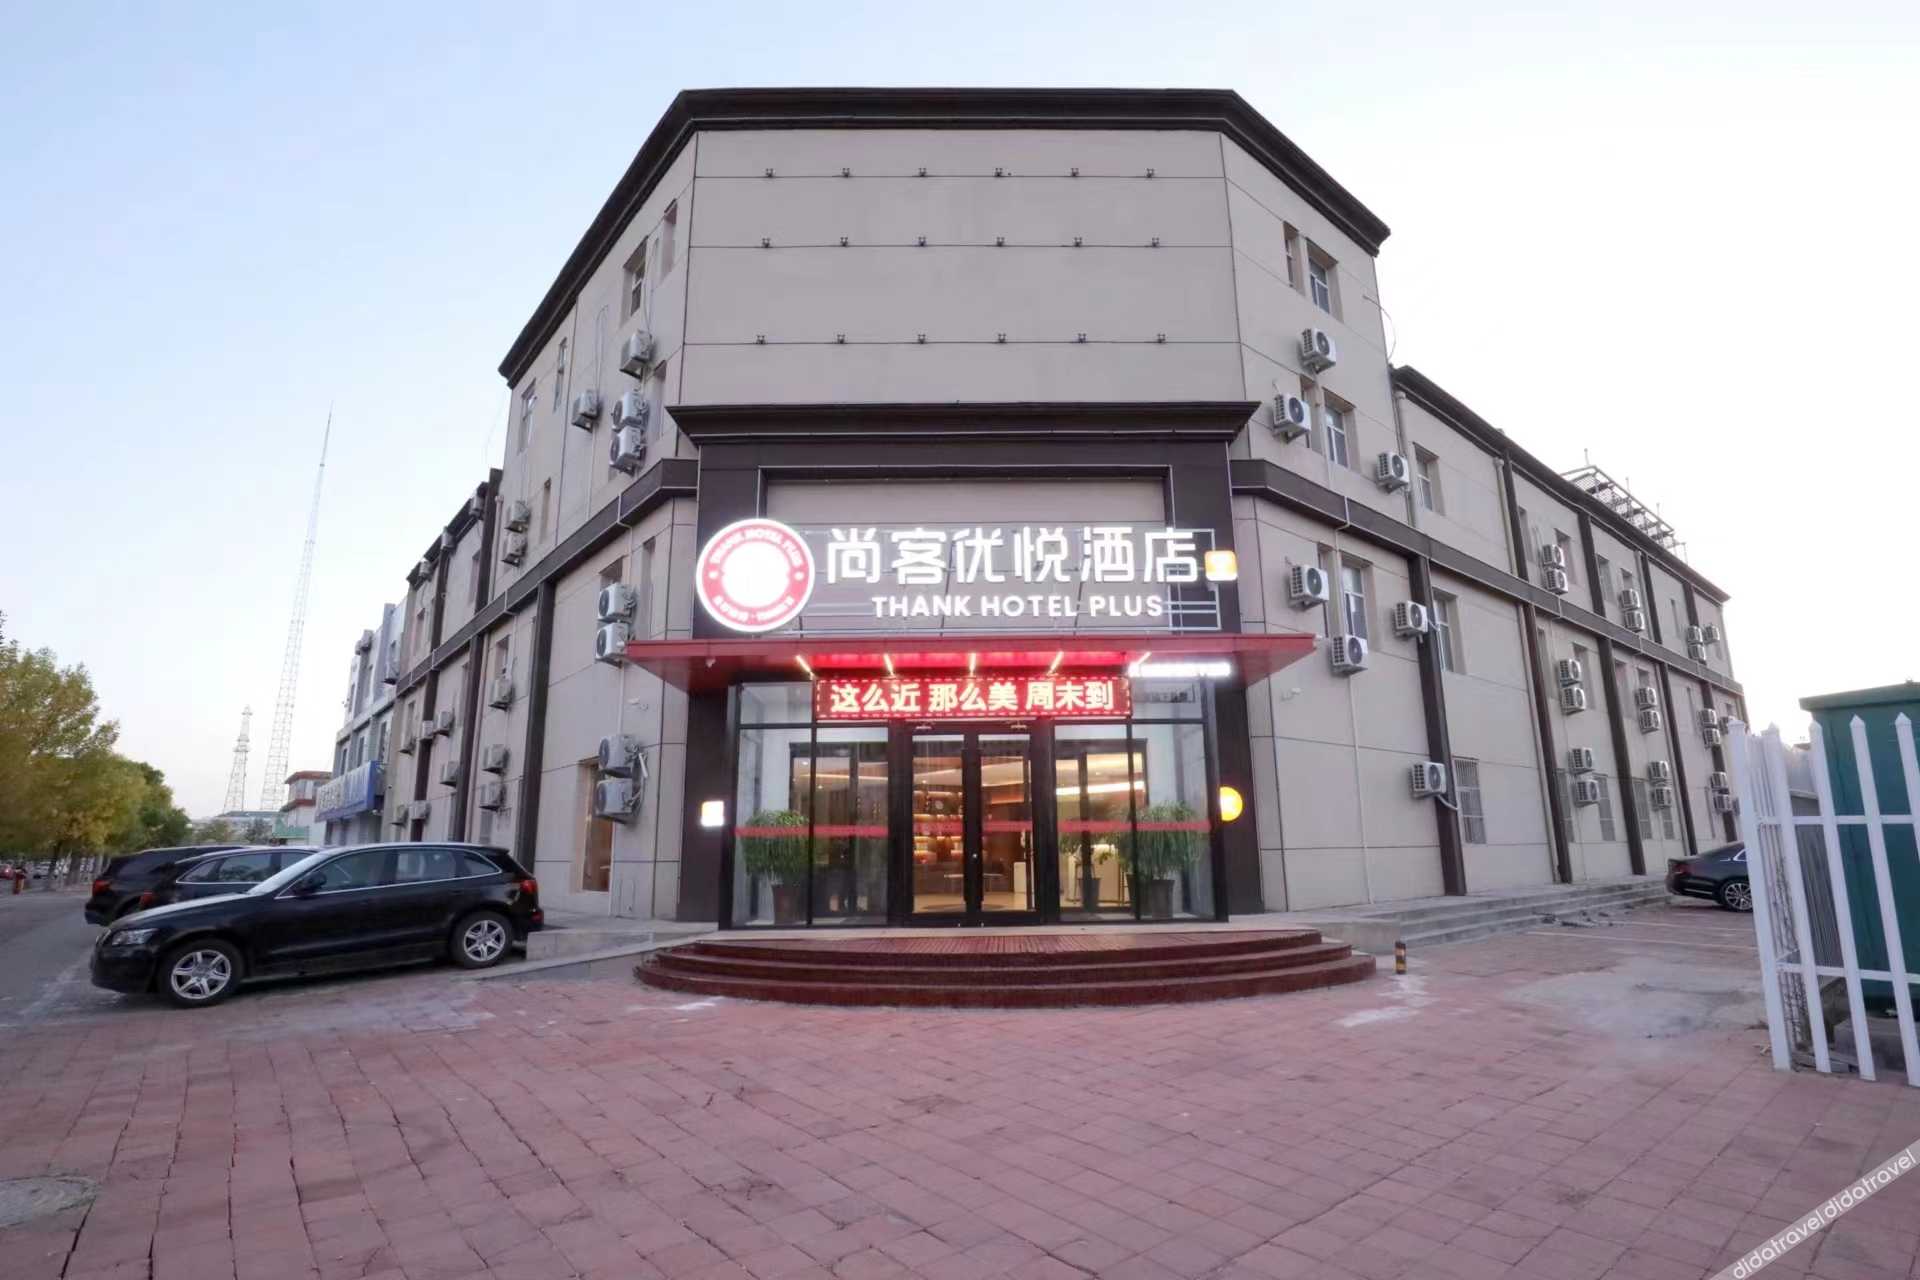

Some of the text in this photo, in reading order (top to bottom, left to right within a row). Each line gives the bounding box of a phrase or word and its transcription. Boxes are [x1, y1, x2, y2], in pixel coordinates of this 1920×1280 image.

[828, 526, 1198, 585] 尚客优悦酒店
[871, 594, 1163, 618] THANK HOTEL PLUS
[831, 680, 1114, 713] 这么近 那么美 周末到
